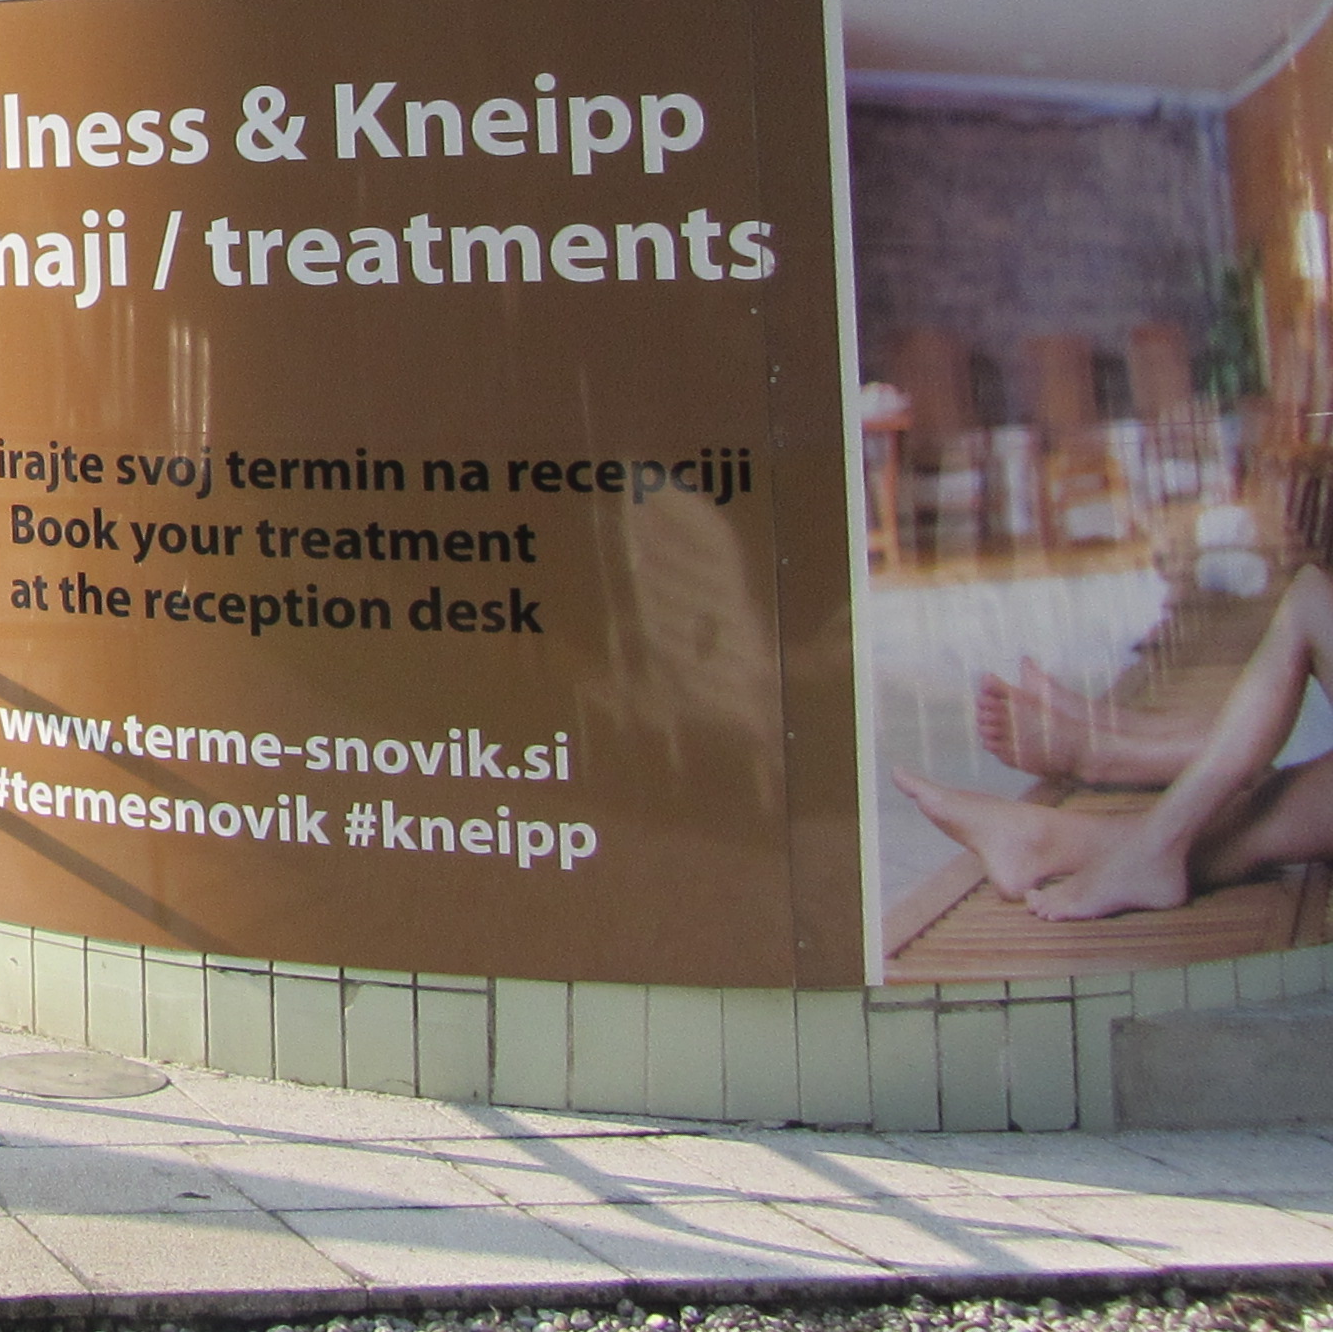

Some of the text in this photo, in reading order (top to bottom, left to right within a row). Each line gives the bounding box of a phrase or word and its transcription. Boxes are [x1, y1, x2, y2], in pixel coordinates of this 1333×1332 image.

[236, 85, 307, 162] &
[335, 73, 704, 175] Kneipp
[153, 210, 183, 291] /
[205, 209, 775, 287] treatments
[116, 446, 212, 500] svoj
[225, 447, 407, 493] termin
[422, 459, 491, 494] na
[506, 447, 754, 506] recepciji
[11, 504, 538, 565] Book your treatment
[10, 572, 544, 637] at the reception desk
[344, 800, 597, 870] #kneipp
